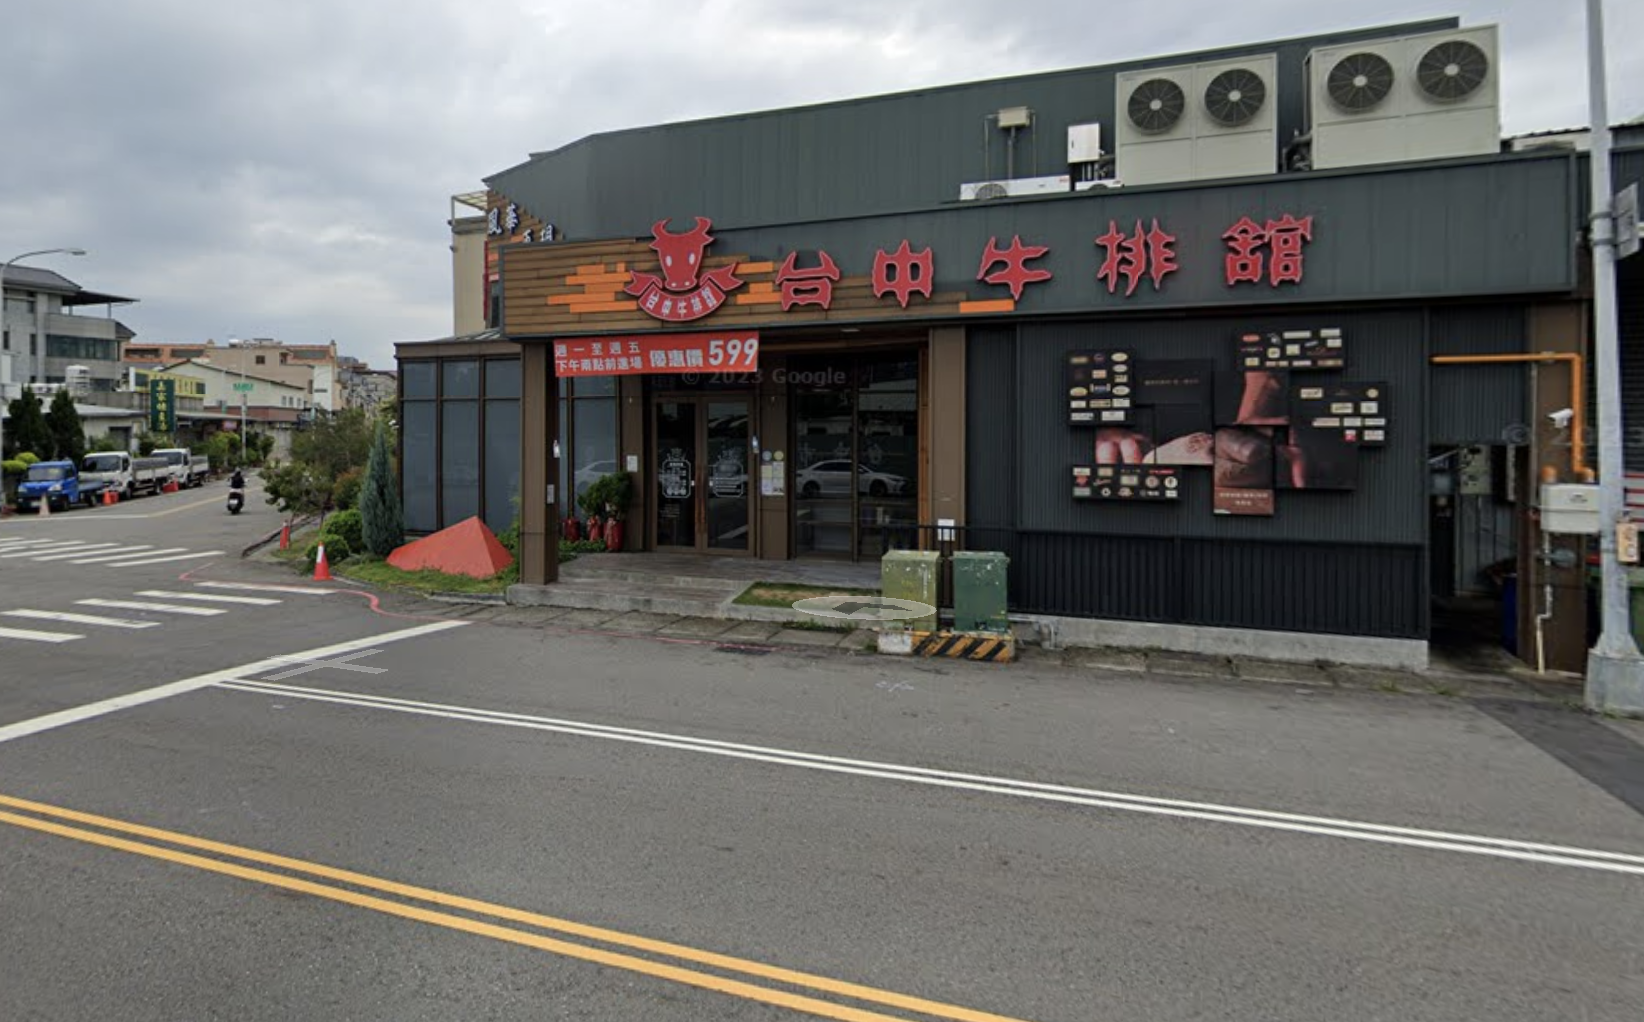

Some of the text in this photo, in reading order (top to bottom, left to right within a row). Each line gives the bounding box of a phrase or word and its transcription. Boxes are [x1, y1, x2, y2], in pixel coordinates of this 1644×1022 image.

[774, 215, 1313, 312] 台中牛排館
[708, 339, 758, 366] 599
